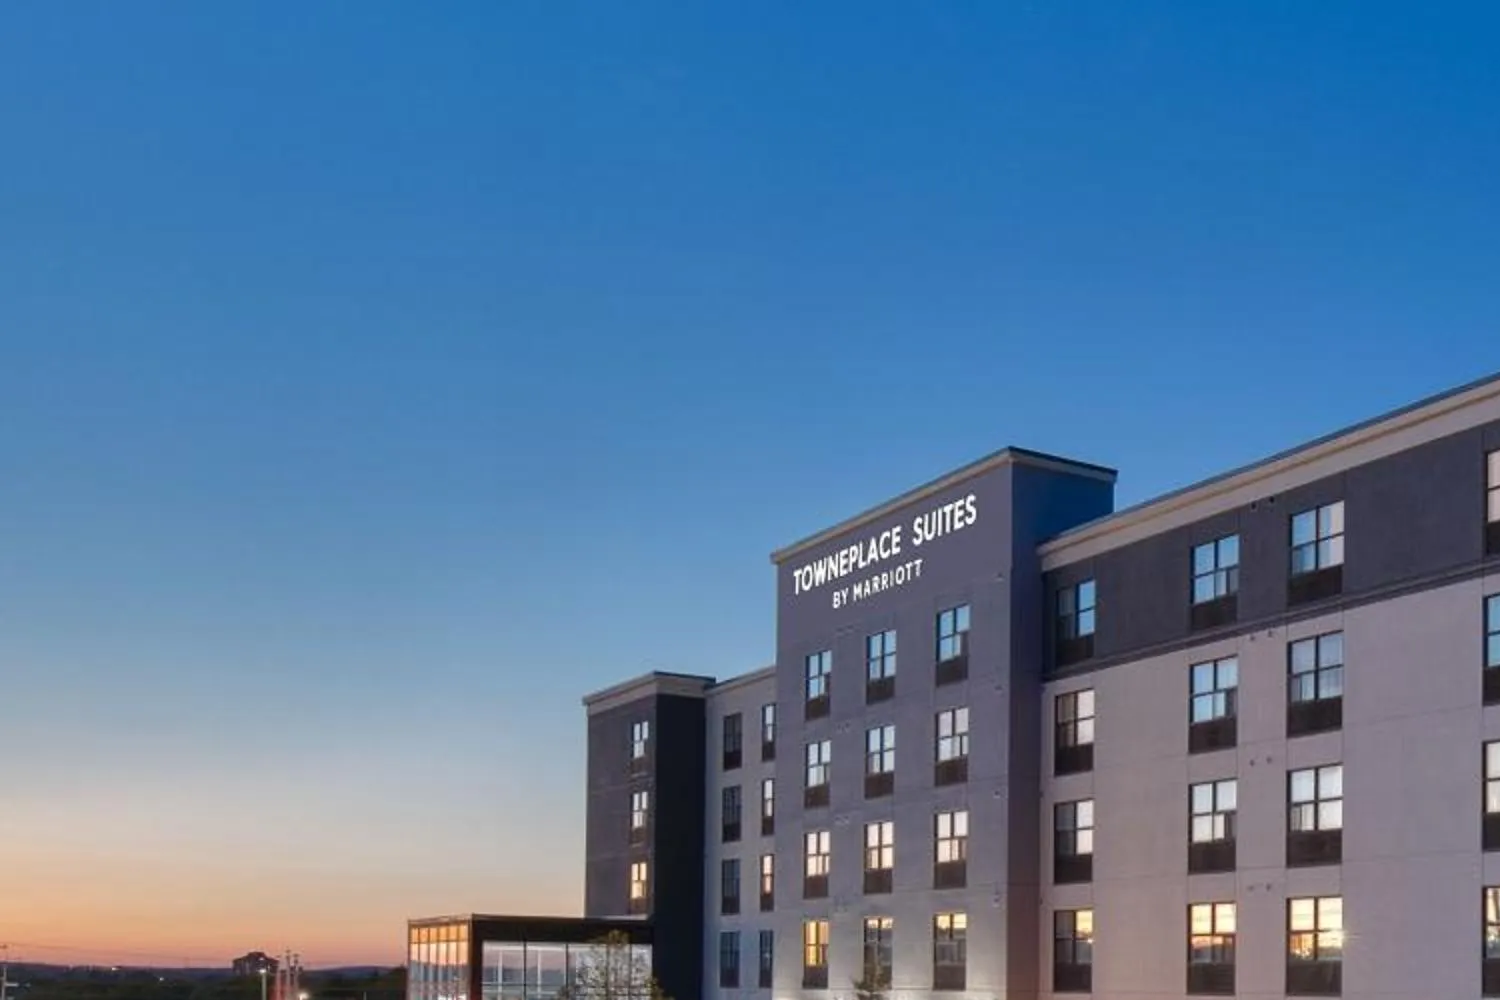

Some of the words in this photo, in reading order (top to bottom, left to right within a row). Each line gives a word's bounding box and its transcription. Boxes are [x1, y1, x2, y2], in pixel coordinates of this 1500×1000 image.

[793, 526, 902, 595] TOWNEPLACE
[912, 494, 977, 546] SUITES
[832, 587, 849, 609] BY
[853, 559, 923, 601] MARRIOTT
